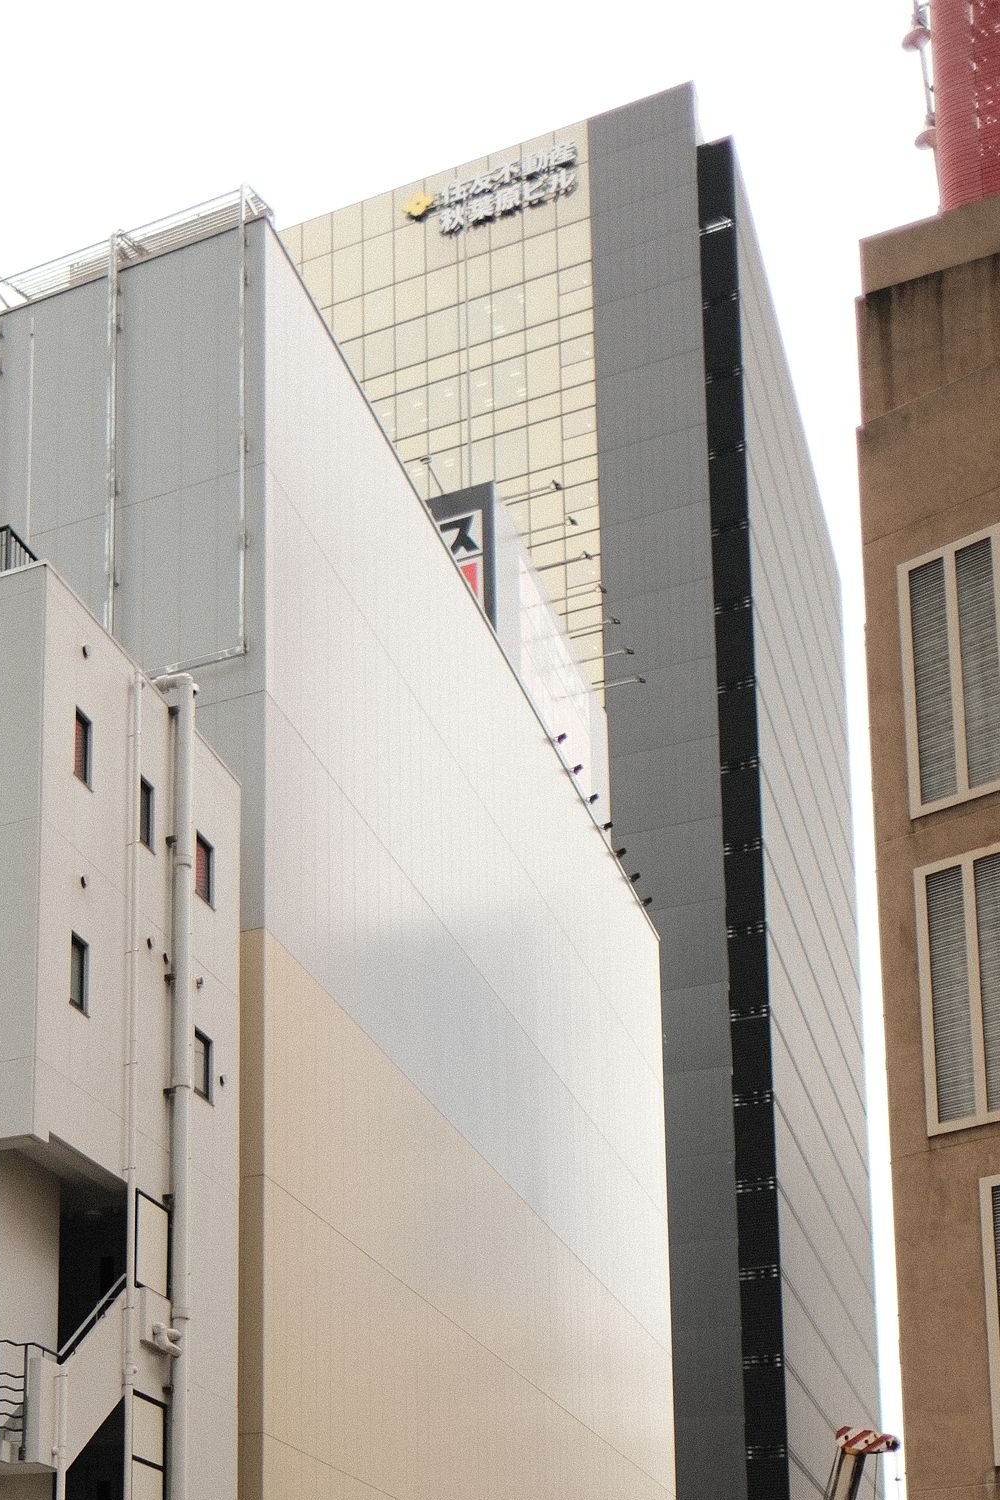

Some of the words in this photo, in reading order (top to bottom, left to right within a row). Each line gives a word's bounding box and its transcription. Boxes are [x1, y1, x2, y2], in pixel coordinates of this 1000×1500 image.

[440, 142, 577, 206] 住友不動産
[440, 168, 577, 234] 秋葉原ビル
